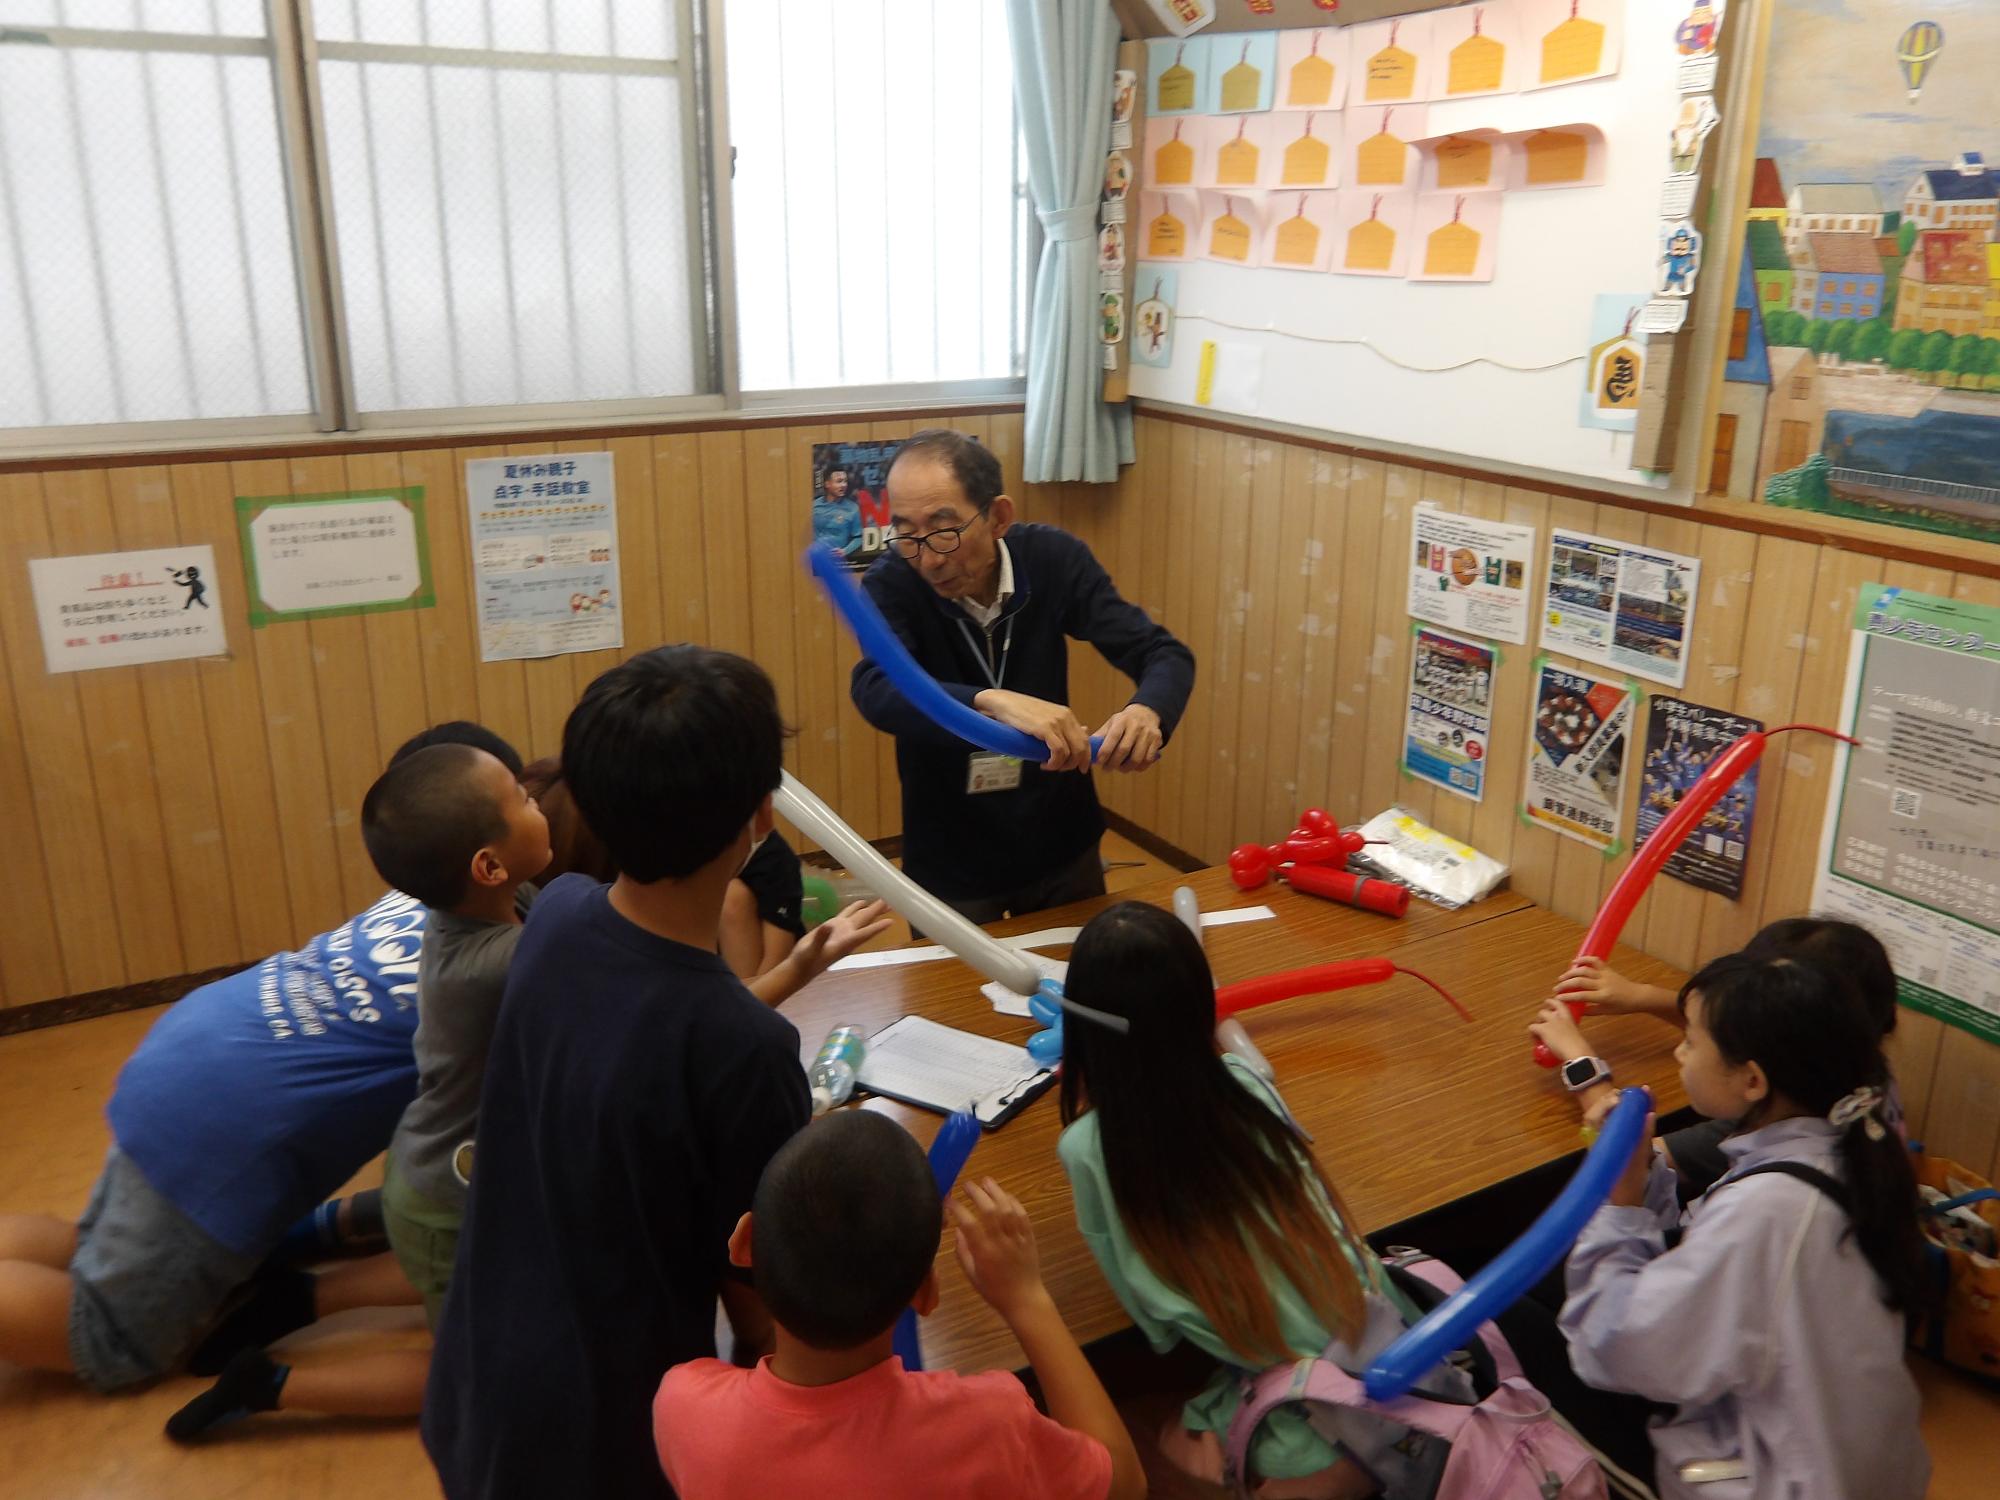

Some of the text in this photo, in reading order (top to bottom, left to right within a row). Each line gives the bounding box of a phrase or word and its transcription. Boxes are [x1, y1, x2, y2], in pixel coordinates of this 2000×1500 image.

[503, 461, 577, 479] 夏休み親子
